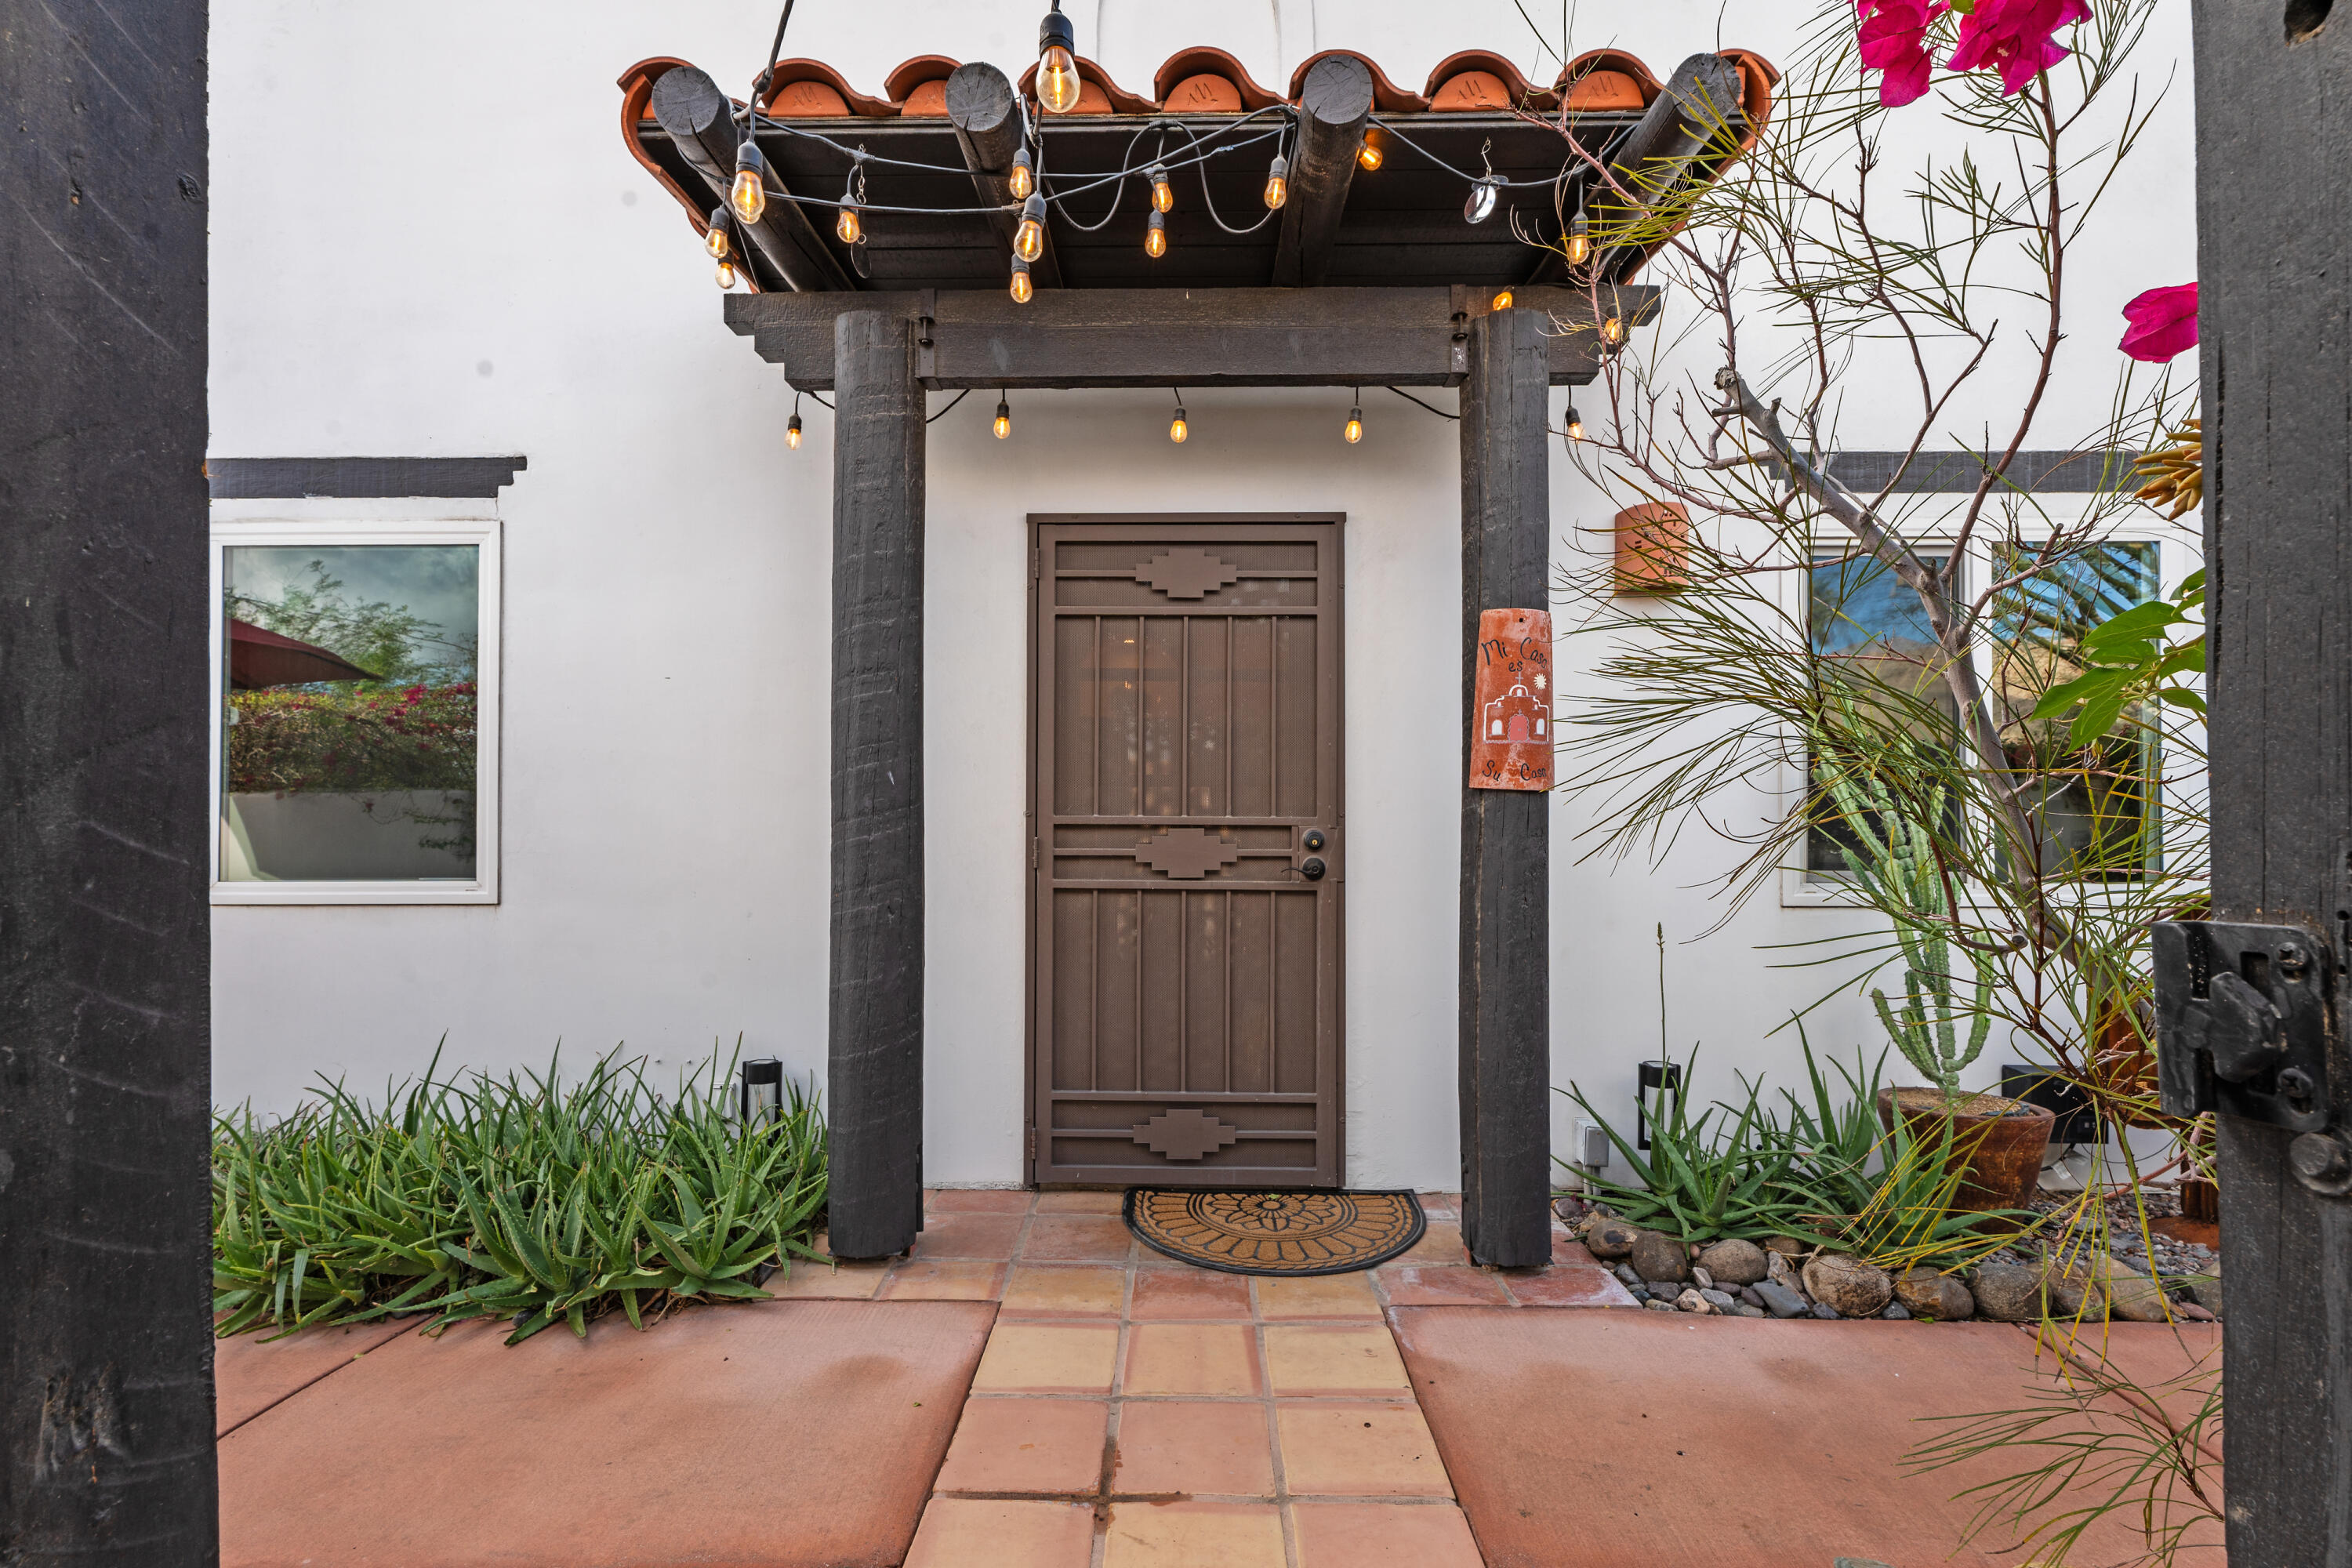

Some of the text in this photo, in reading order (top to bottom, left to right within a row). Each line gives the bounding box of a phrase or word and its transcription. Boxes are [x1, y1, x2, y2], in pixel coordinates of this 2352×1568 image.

[1481, 637, 1548, 670] Mi Casa
[1508, 659, 1523, 672] es
[1482, 760, 1547, 782] Su Casa
